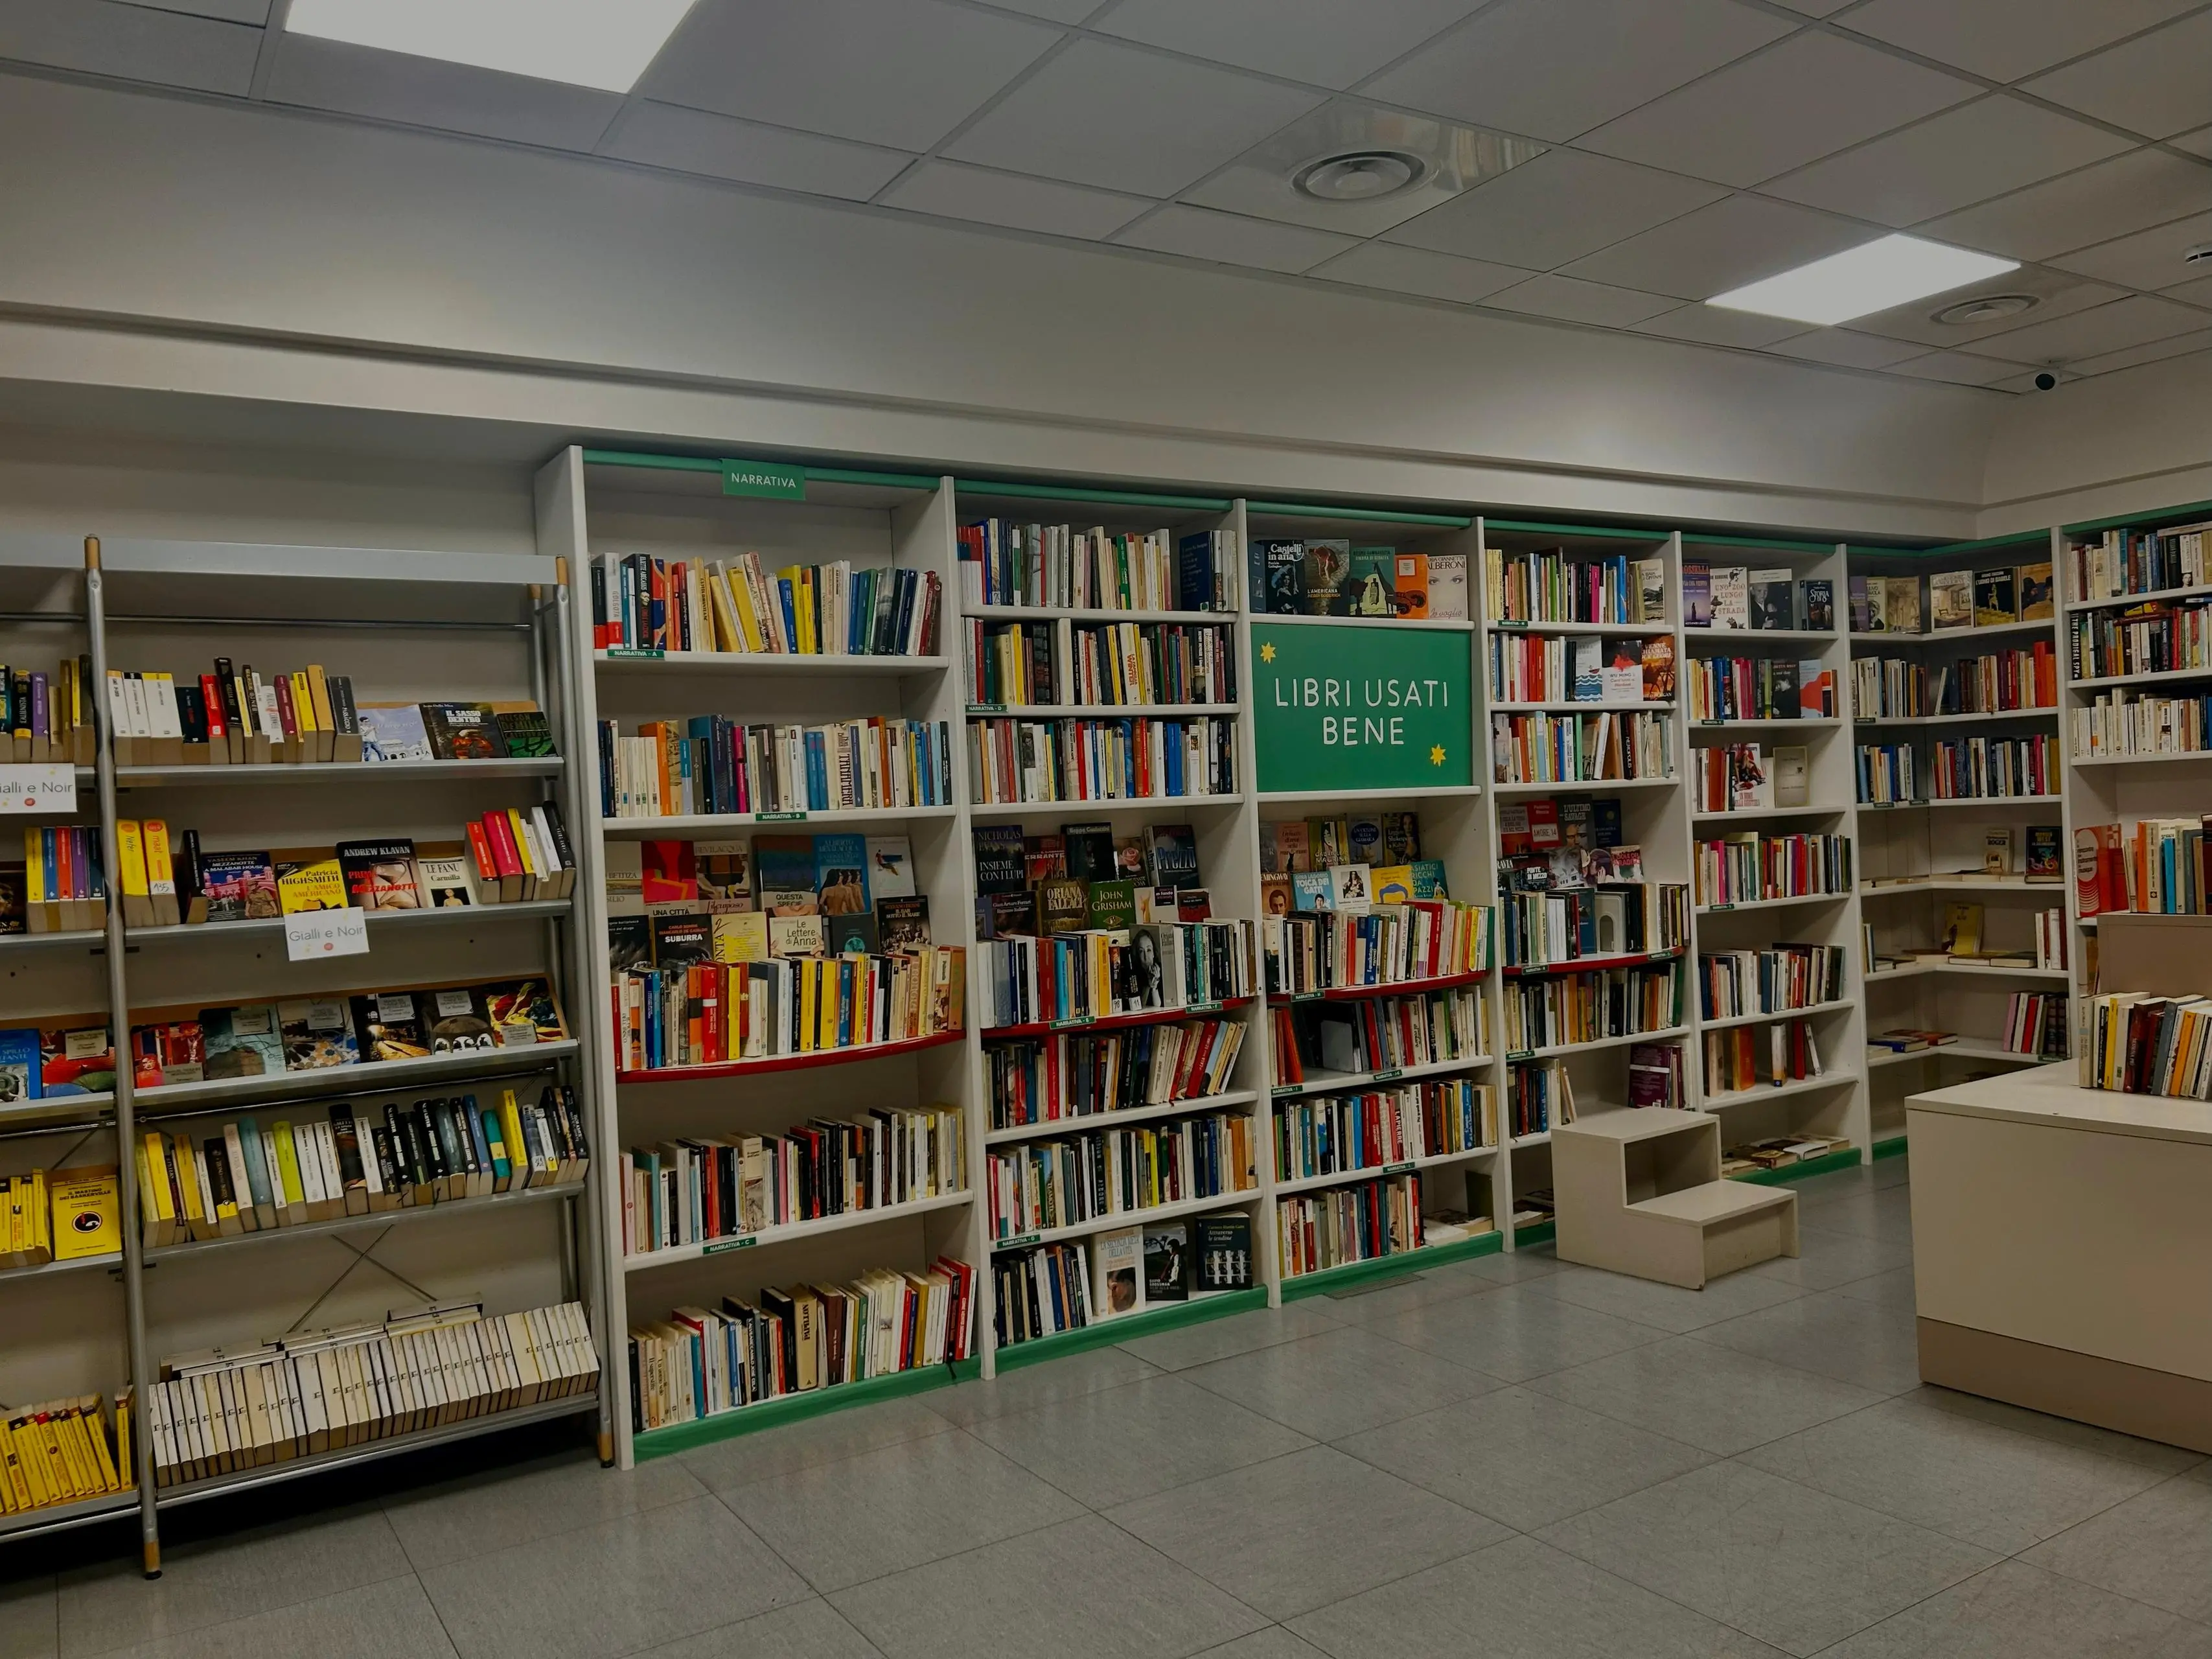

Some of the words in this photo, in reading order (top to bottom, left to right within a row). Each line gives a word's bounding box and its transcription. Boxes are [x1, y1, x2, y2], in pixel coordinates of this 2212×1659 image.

[732, 472, 796, 488] NARRATIVA
[1270, 543, 1302, 555] Castelli
[1267, 552, 1274, 561] in
[1438, 607, 1463, 620] voglio
[2071, 631, 2080, 660] PRODIGAL
[1126, 654, 1135, 686] WINTER
[1274, 677, 1350, 708] LIBRI
[1365, 679, 1448, 708] USATI
[501, 713, 531, 721] NELSON
[1322, 716, 1405, 745] BENE
[838, 753, 853, 806] TANAMERA
[0, 782, 21, 794] ialli
[27, 785, 36, 794] e
[42, 782, 72, 794] Noir
[977, 830, 1022, 841] NICHOLAS
[1533, 828, 1550, 837] AMORE
[343, 847, 378, 858] ANDREW
[380, 845, 411, 855] KLAVAN
[1024, 852, 1066, 861] ERRANTE
[426, 864, 439, 874] LE
[979, 859, 1014, 872] INSIEME
[305, 869, 338, 878] Patricia
[430, 874, 461, 882] Carmilla
[980, 871, 999, 882] CON
[1005, 869, 1024, 881] LUPI
[1261, 872, 1289, 882] EMINGWAY
[281, 875, 340, 886] HIGHSMITH
[1317, 877, 1330, 886] DEI
[293, 888, 341, 898] AMERICANO
[1046, 886, 1082, 899] ORIANA
[1304, 885, 1324, 894] GATTI
[1413, 886, 1434, 894] PAZZI
[1099, 890, 1123, 902] JOHN
[1048, 896, 1083, 911] FALLACI
[1091, 899, 1133, 911] GRISHAM
[796, 919, 806, 928] Le
[290, 928, 321, 942] Gialli
[325, 930, 334, 938] e
[337, 925, 364, 938] Noir
[664, 933, 704, 943] SUBURRA
[787, 928, 816, 937] Lettere
[792, 936, 816, 946] Anna
[1394, 1109, 1403, 1144] LAPIERRE
[709, 1240, 740, 1253] NARRATIVA
[1002, 1237, 1028, 1246] NARRATIVA
[802, 1303, 811, 1341] PAPILLON
